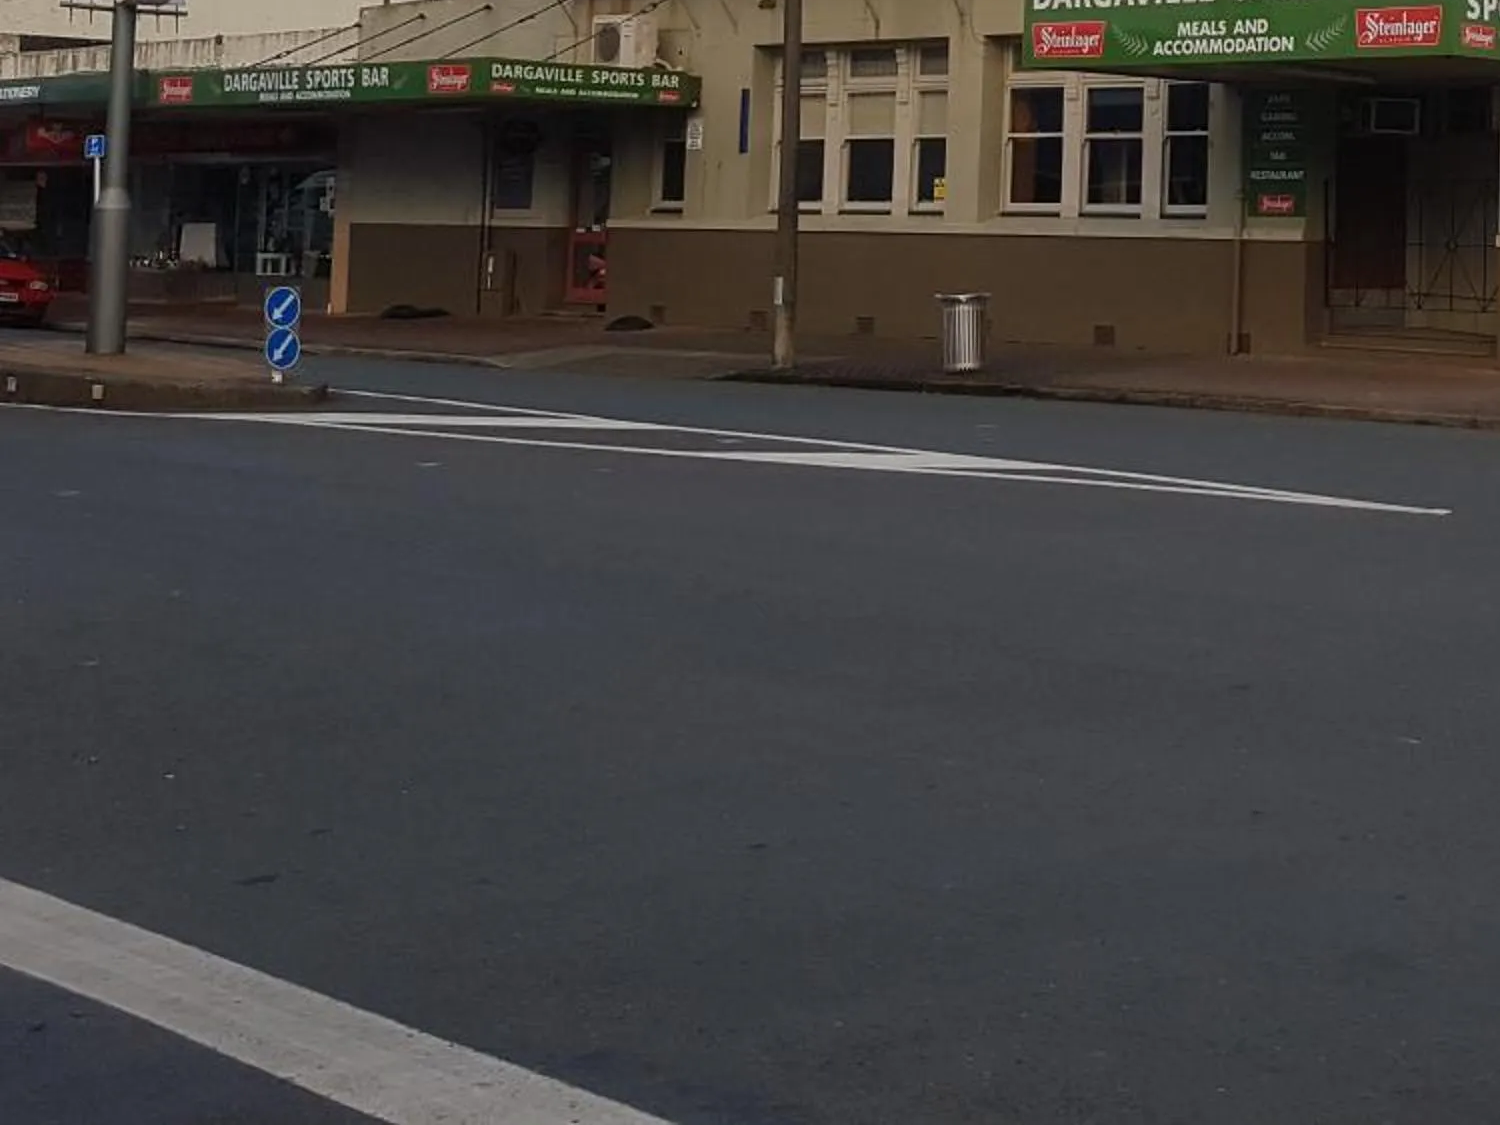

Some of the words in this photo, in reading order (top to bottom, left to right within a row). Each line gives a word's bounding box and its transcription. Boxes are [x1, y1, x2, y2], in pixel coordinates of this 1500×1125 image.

[1177, 19, 1227, 38] MEALS
[1233, 18, 1269, 35] AND
[1359, 11, 1439, 44] Steinlager
[1036, 26, 1101, 55] Steinlager
[1153, 35, 1295, 56] ACCOMMODATION
[224, 71, 299, 92] DARGAVILLE
[305, 69, 355, 89] SPORTS
[361, 67, 390, 87] BAR
[490, 62, 585, 84] DARGAVILLE
[591, 70, 645, 87] SPORTS
[651, 74, 680, 88] BAR
